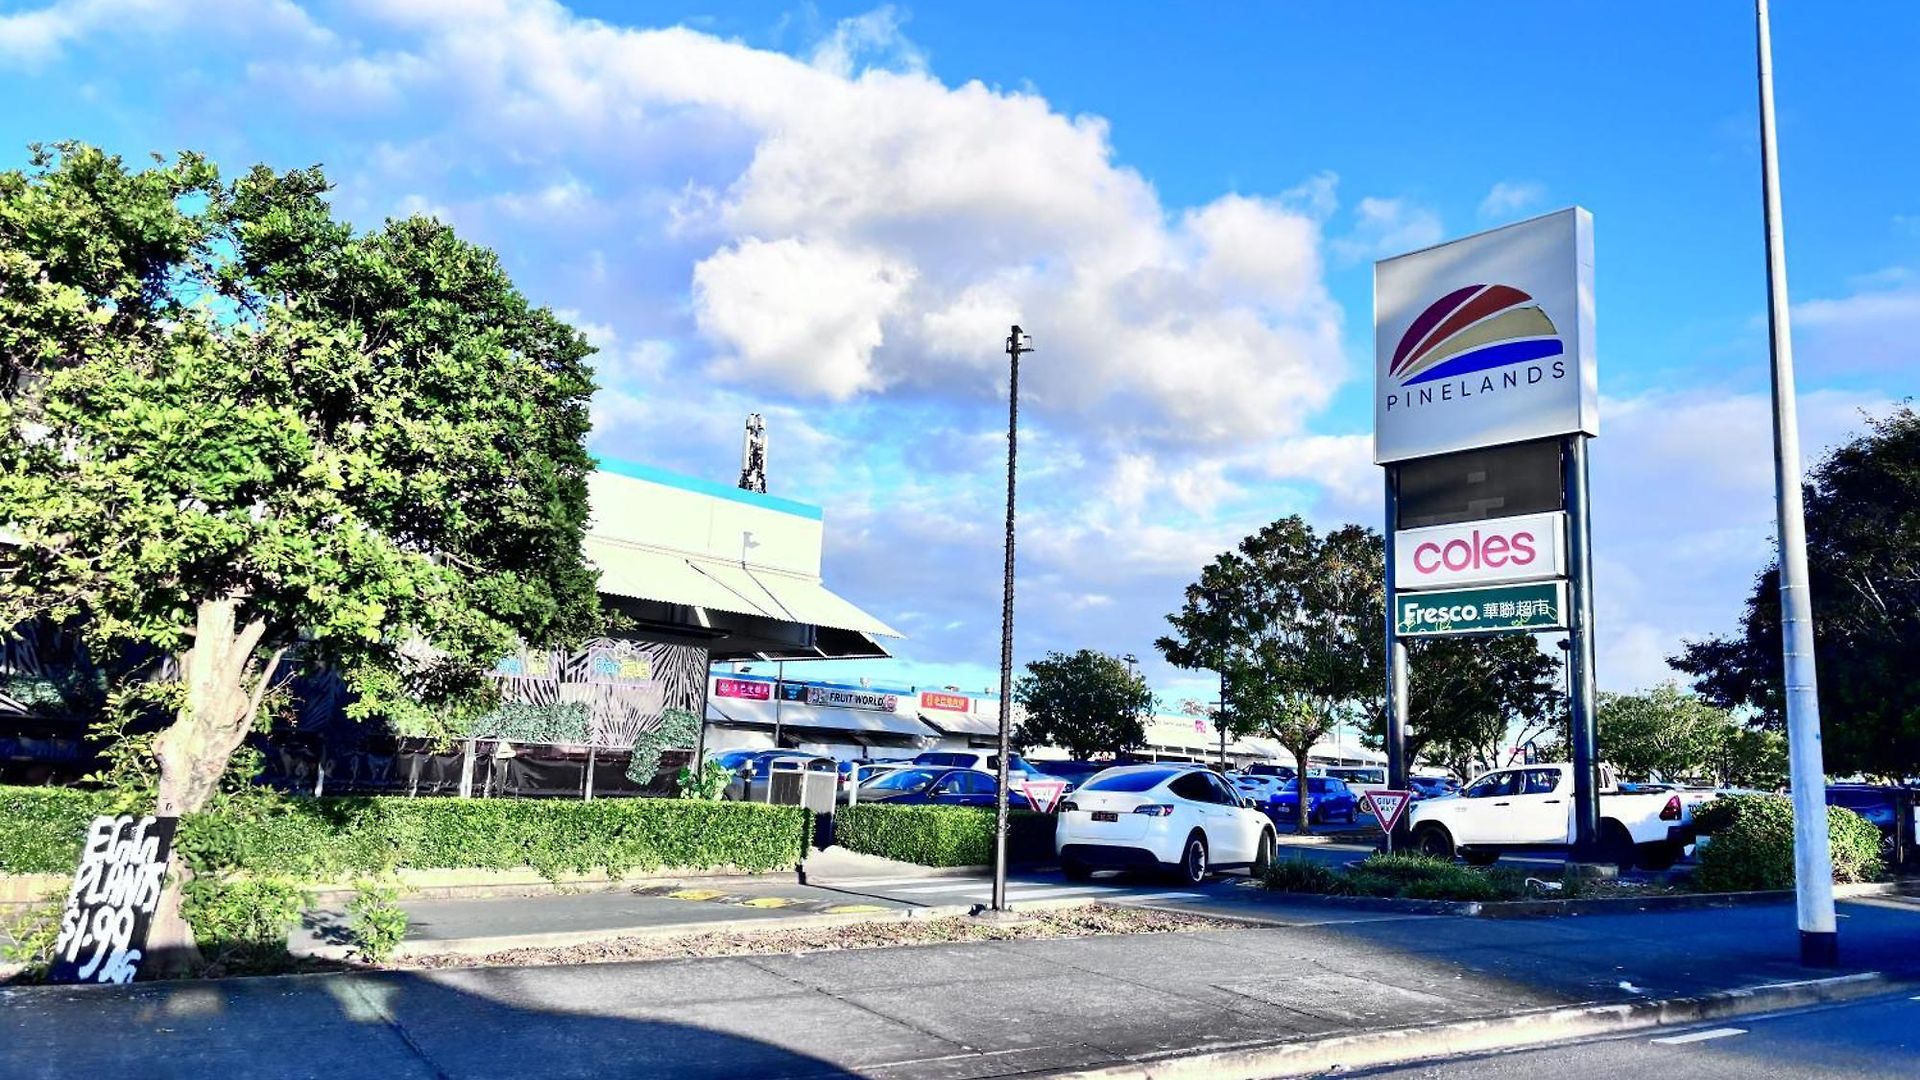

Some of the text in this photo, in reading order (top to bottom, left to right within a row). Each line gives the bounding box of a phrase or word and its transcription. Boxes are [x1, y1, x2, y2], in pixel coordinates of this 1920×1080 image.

[1387, 361, 1566, 411] PINELANDS
[1414, 530, 1536, 574] coles
[1483, 599, 1549, 619] 華聯超市
[829, 692, 884, 706] FRUIT WORLD
[1376, 797, 1397, 805] GIVE
[83, 815, 160, 866] EGG
[67, 859, 169, 914] PLANTS
